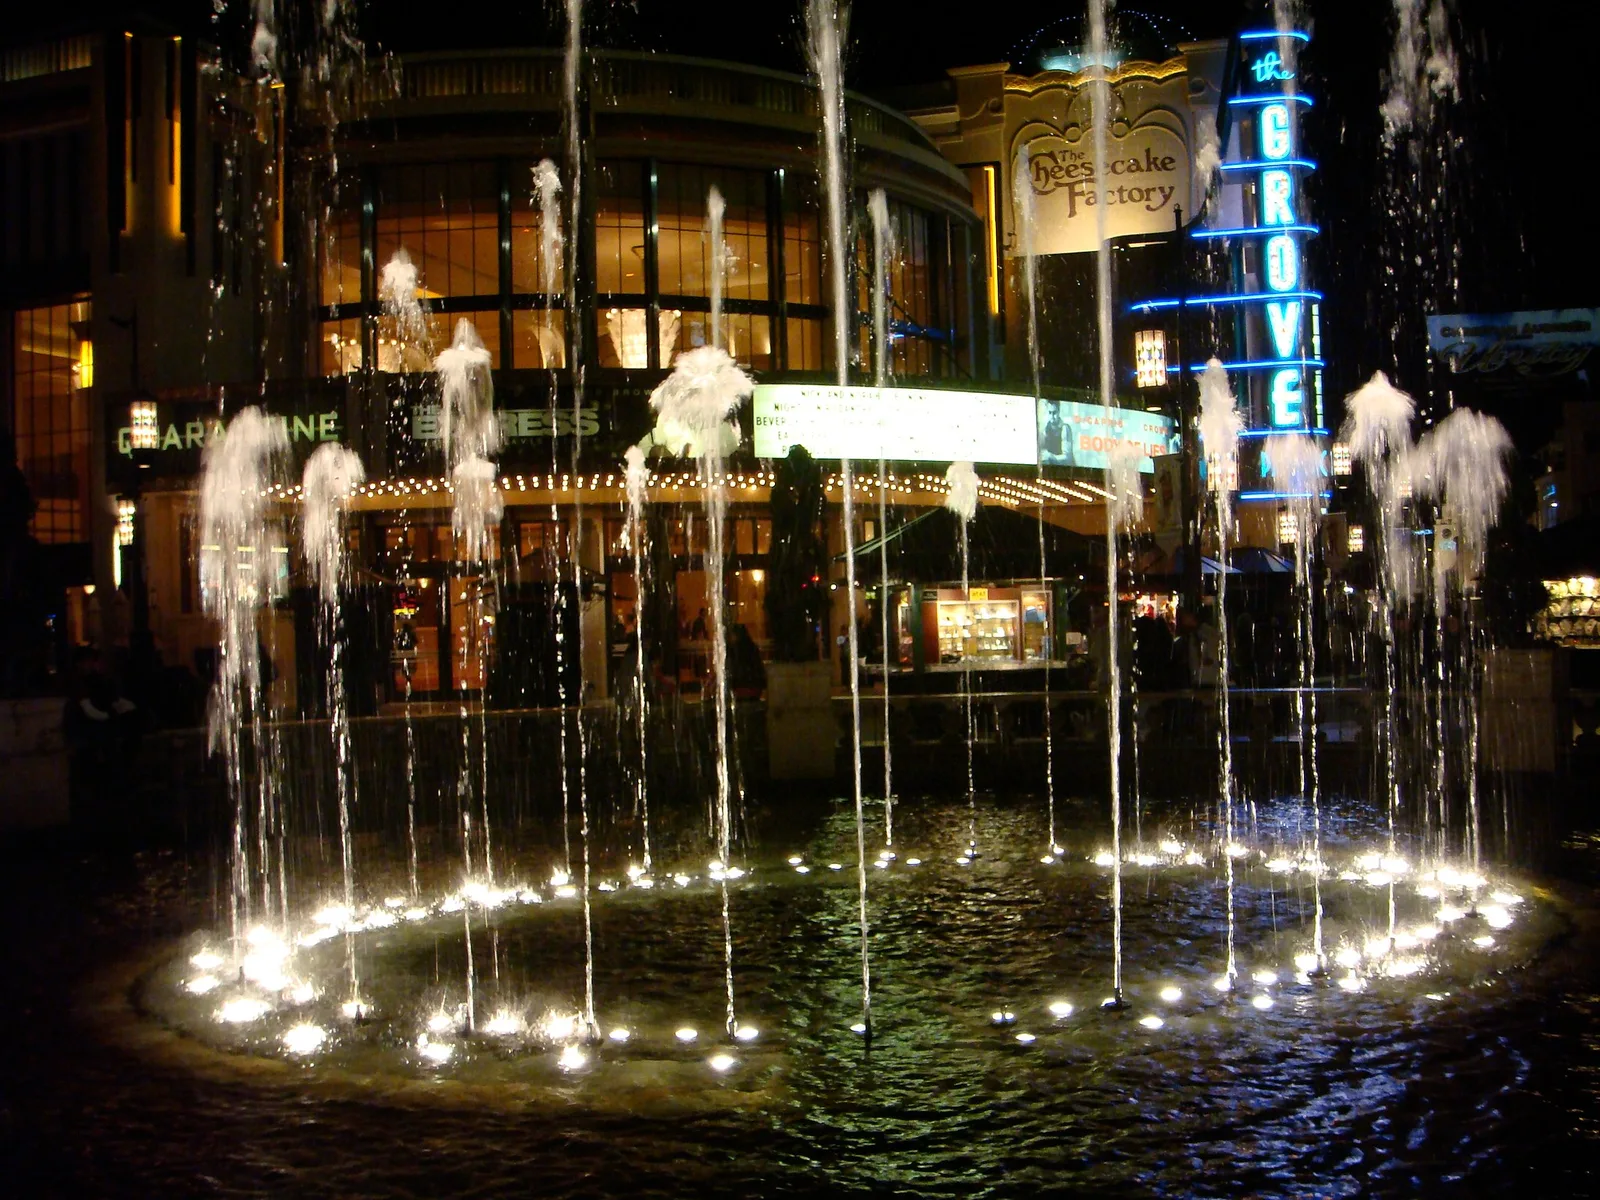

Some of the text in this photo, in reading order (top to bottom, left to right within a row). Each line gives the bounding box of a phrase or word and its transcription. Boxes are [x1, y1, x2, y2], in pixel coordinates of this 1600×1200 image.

[1251, 51, 1295, 82] the
[1058, 149, 1085, 163] The
[1054, 178, 1175, 218] Factory
[1261, 104, 1302, 426] GROVE
[118, 412, 339, 459] QARAINE
[412, 409, 600, 439] ERESS
